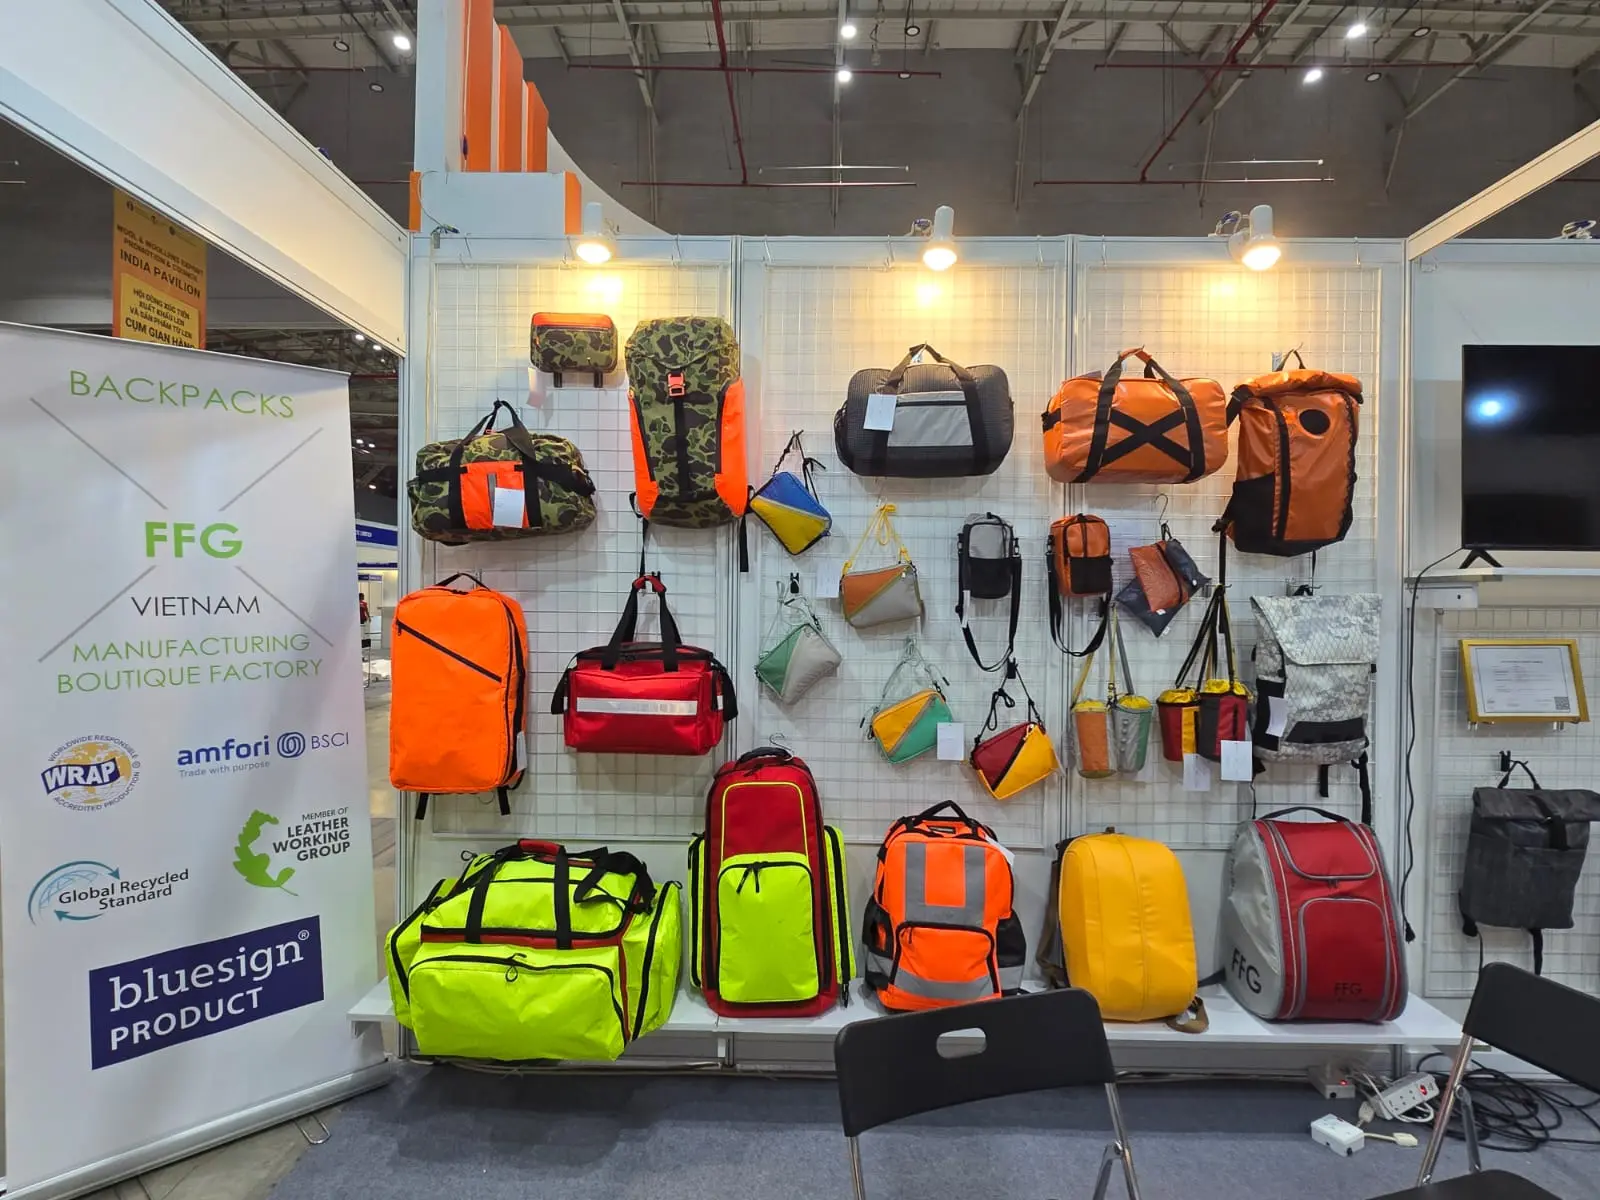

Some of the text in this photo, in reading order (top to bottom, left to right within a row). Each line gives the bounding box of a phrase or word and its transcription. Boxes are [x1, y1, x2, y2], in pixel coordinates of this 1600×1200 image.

[120, 249, 201, 299] INDIA PAVILION
[148, 328, 171, 344] GIAN
[69, 369, 294, 418] BACKPACKS
[144, 521, 243, 559] FFG
[131, 595, 260, 616] VIETNAM
[72, 634, 310, 663] MANUFACTURING
[57, 658, 322, 694] BOUTIQUE FACTORY
[48, 734, 139, 762] WORLDWIDE RESPONSIBLE
[177, 731, 349, 766] amfori BSCI
[44, 760, 115, 790] WRAP
[179, 761, 270, 778] Trade with purpose
[53, 771, 140, 812] ACCREDITED PRODUCTION
[287, 817, 349, 838] LEATHER
[302, 807, 349, 821] MEMBER OF
[273, 829, 350, 853] WORKING
[297, 841, 350, 862] GROUP
[58, 869, 189, 905] Global Recycled
[99, 884, 172, 910] Standard
[1231, 947, 1262, 994] FFG
[1334, 982, 1363, 997] FFG
[110, 987, 263, 1051] PRODUCT
